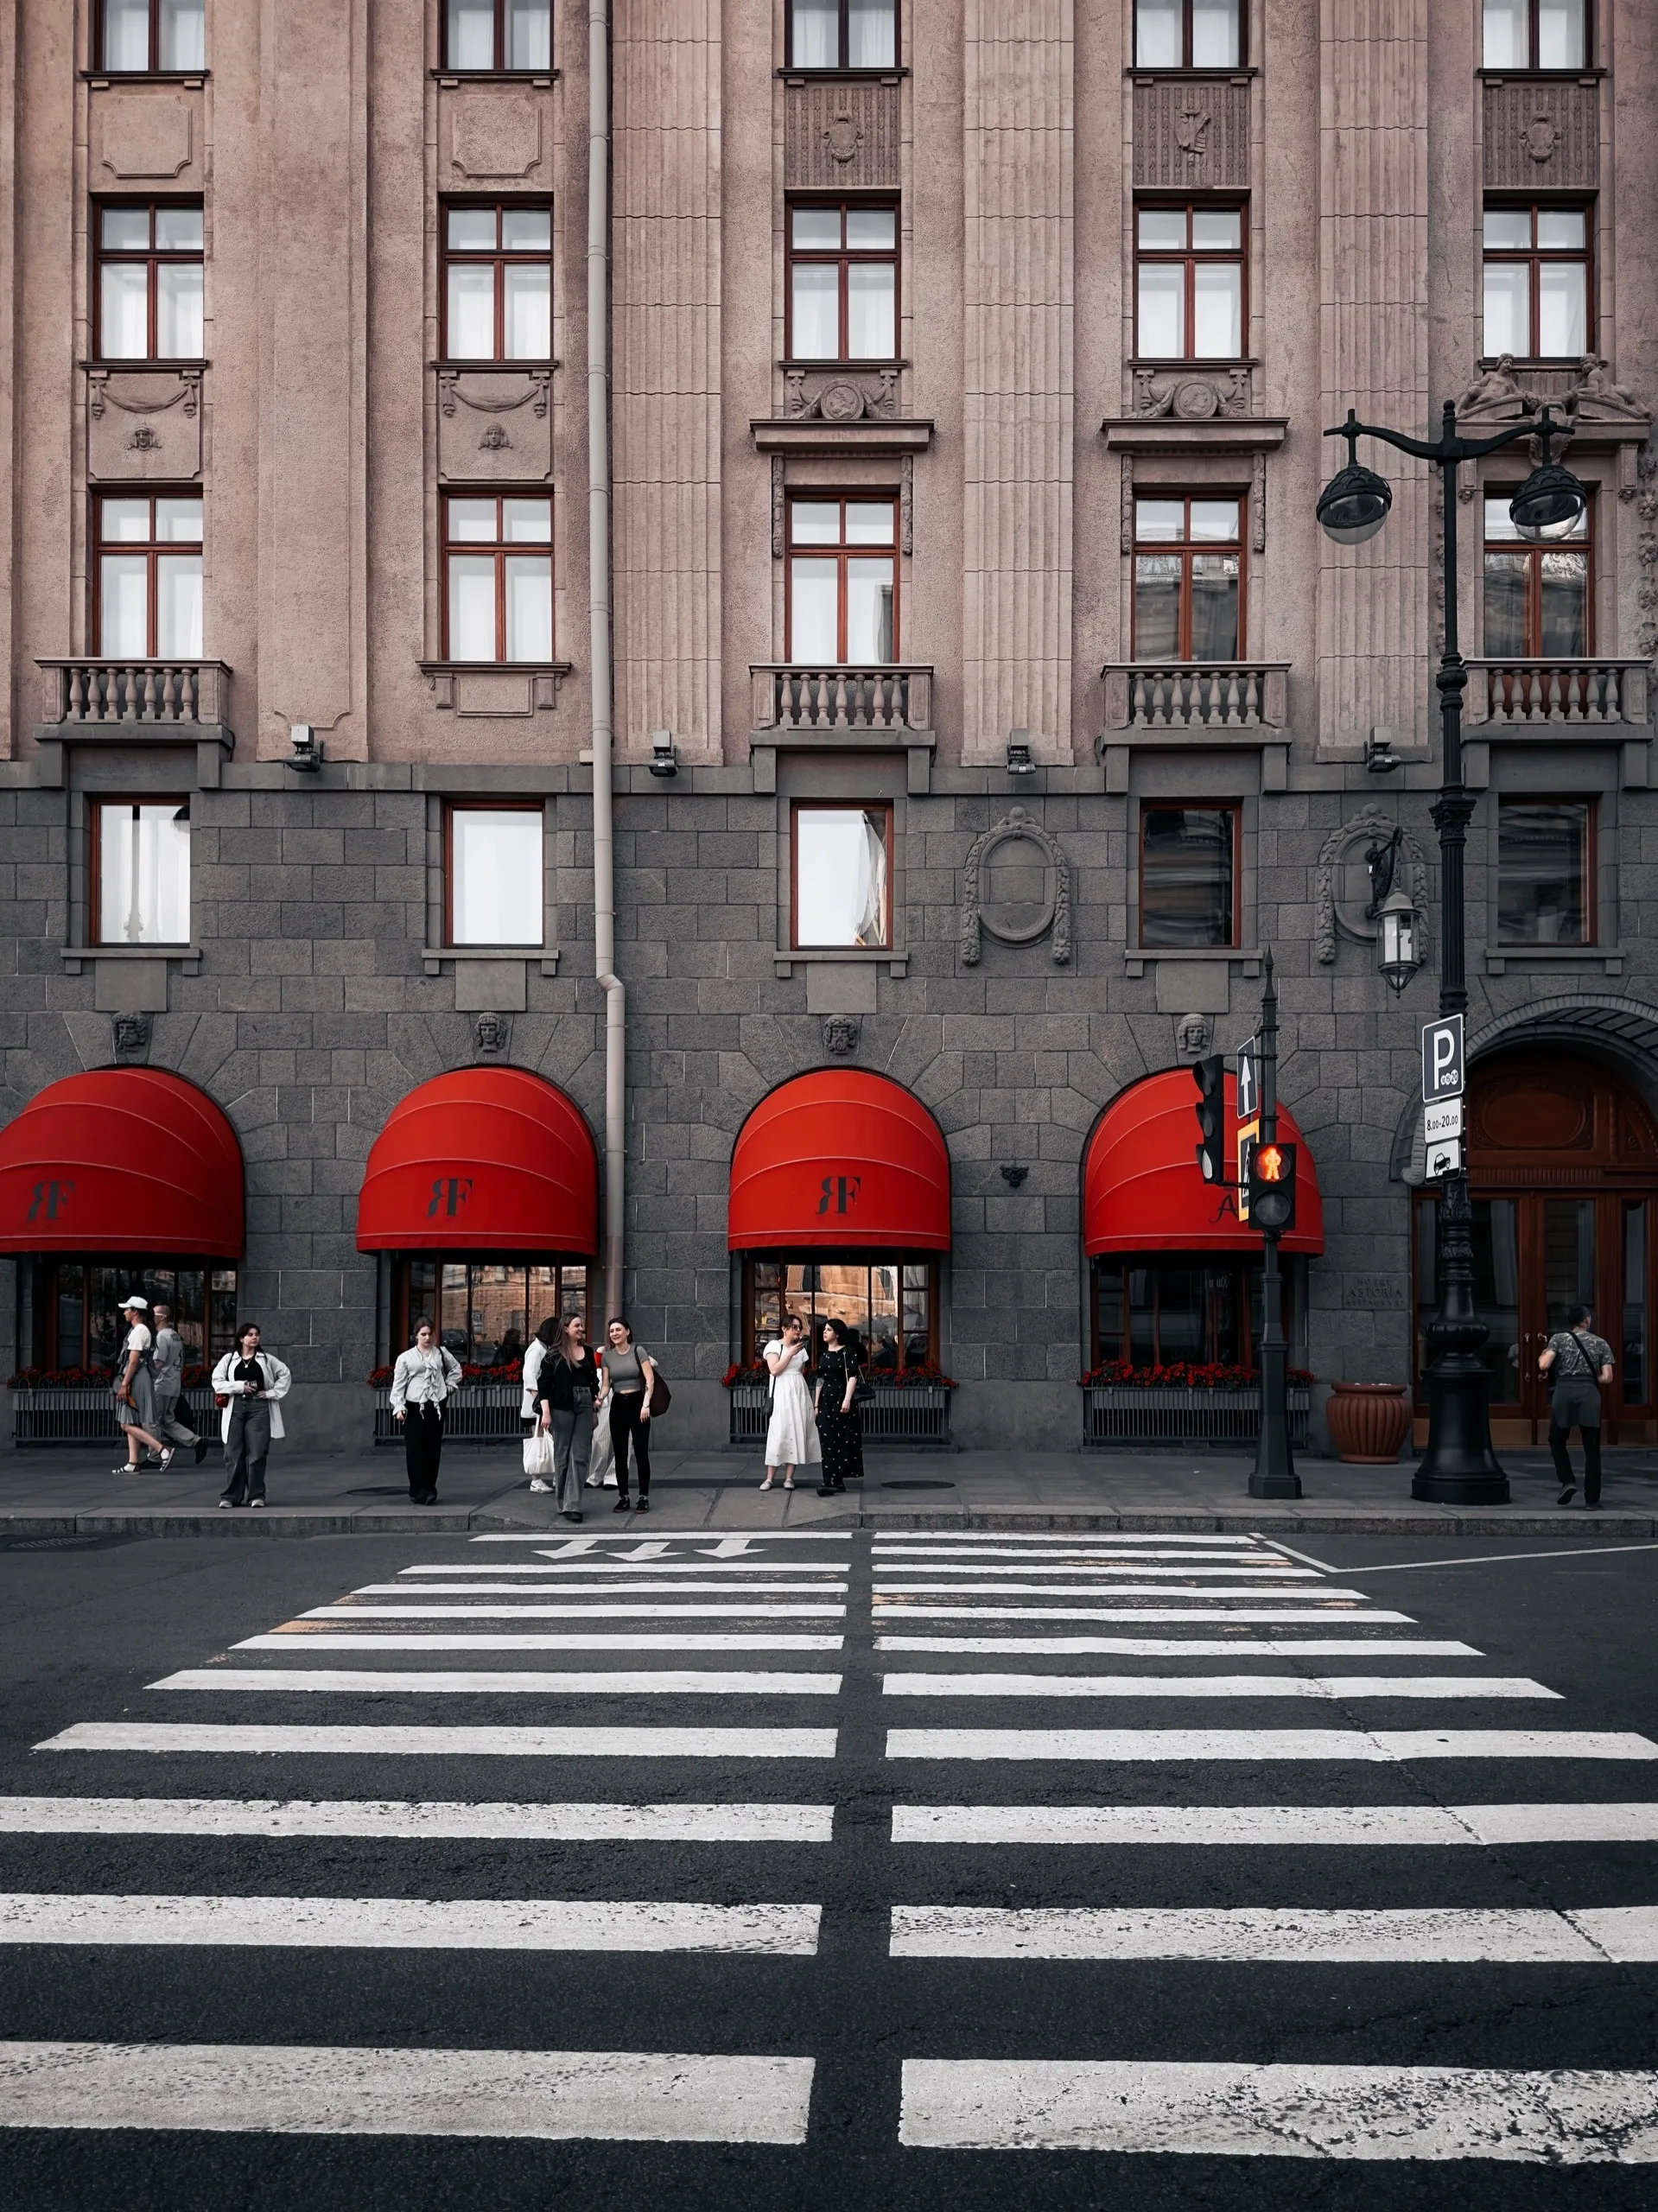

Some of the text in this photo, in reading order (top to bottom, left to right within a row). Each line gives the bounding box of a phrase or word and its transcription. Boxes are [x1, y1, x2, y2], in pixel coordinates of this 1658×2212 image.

[1433, 1029, 1455, 1090] P
[1426, 1115, 1458, 1131] 8.00-20.00
[1350, 1287, 1403, 1297] ASTORIA
